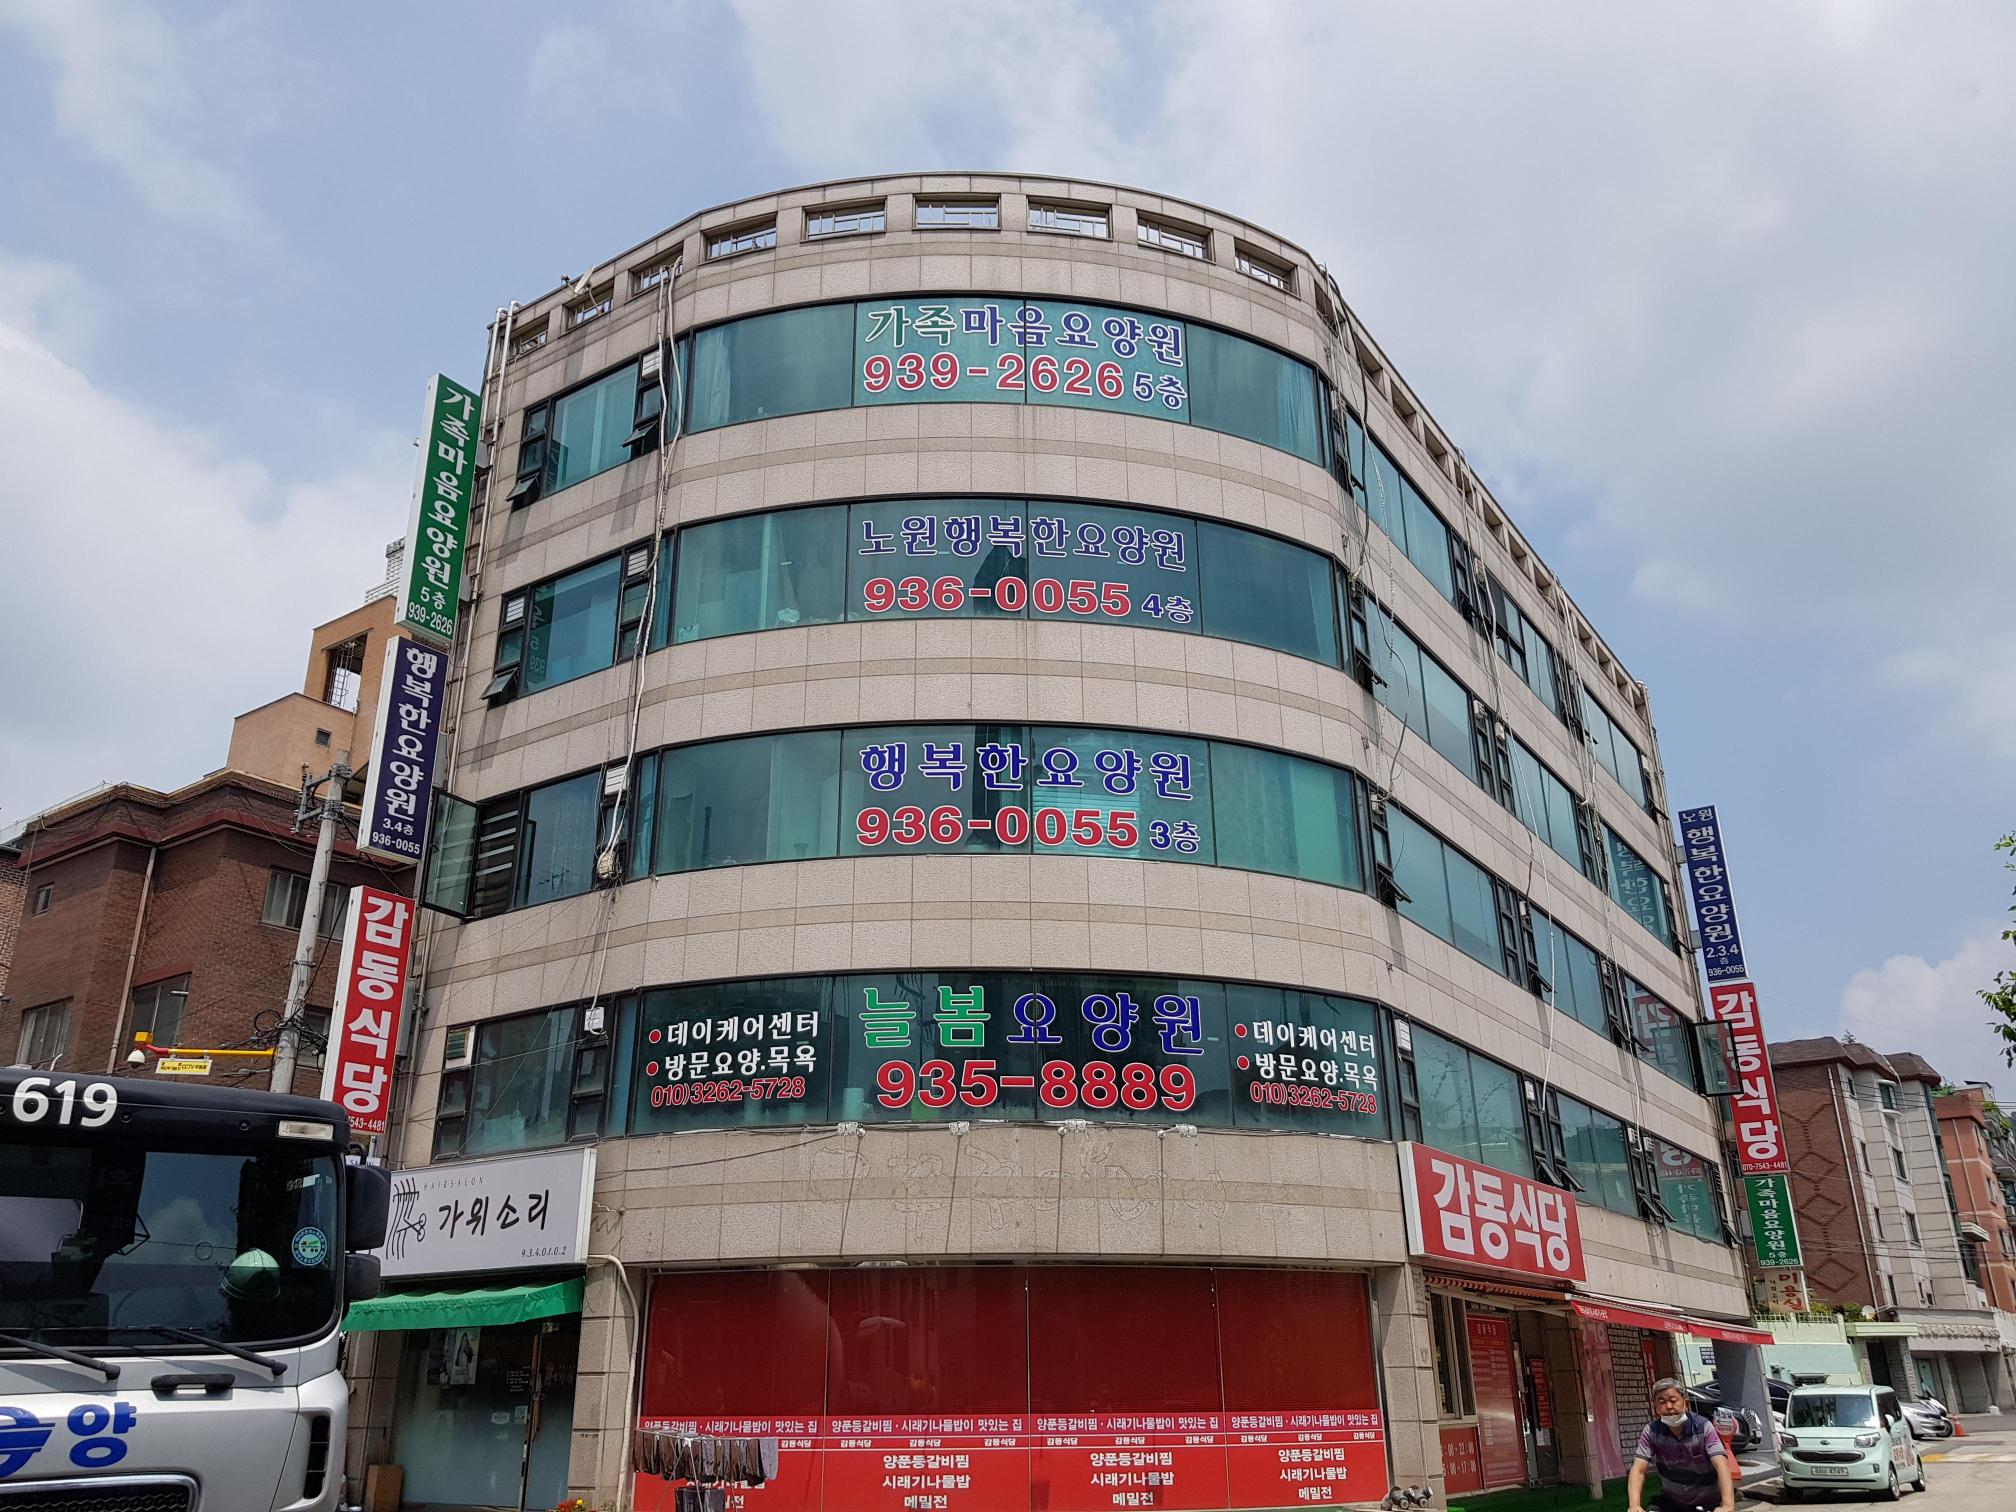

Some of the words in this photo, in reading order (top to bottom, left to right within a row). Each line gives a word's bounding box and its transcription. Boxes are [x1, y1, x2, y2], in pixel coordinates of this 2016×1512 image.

[863, 352, 1124, 399] 939-2626
[1132, 373, 1188, 410] 5층
[421, 386, 475, 590] 가족마음요양원
[420, 586, 446, 610] 5층
[863, 576, 1131, 617] 936-0055
[1142, 594, 1193, 624] 4층
[408, 601, 453, 635] 939-2626
[385, 647, 438, 822] 행복한요양원
[1682, 807, 1714, 824] 노원
[856, 805, 1139, 848] 936-0055
[1149, 820, 1201, 854] 3층
[372, 831, 421, 855] 936-0055
[1686, 826, 1734, 943] 행복한요양원
[1708, 964, 1745, 977] 936-0055
[341, 895, 409, 1114] 감동식당
[667, 1011, 819, 1047] 데이케어센터
[1252, 1021, 1375, 1059] 데이케어센터
[1716, 990, 1779, 1160] 감동식당
[651, 1076, 806, 1108] 010)3262-5728
[876, 1060, 1196, 1111] 935-8889
[13, 1077, 118, 1127] 619
[1250, 1081, 1377, 1114] 010)3262-5728
[439, 1189, 549, 1239] 가위소리
[1430, 1158, 1571, 1272] 감동식당
[1754, 1178, 1787, 1251] 가족마음요양원
[1760, 1258, 1799, 1266] 939-2626
[705, 1420, 771, 1433] 시래기나물밥이
[775, 1421, 804, 1433] 맛있는
[808, 1421, 818, 1433] 집
[832, 1420, 893, 1433] 양푼등갈비찜
[901, 1419, 974, 1432] 시래기나물밥이
[978, 1418, 1008, 1432] 맛있는
[1012, 1418, 1022, 1432] 집
[1037, 1417, 1098, 1431] 양푼등갈비찜
[1106, 1417, 1174, 1431] 시래기나물밥이
[1178, 1416, 1206, 1430] 맛있는
[1209, 1416, 1219, 1430] 집
[1231, 1415, 1283, 1429] 양푼등갈비찜
[1290, 1414, 1345, 1428] 시래기나물밥이
[1347, 1414, 1369, 1426] 맛있는
[1371, 1414, 1378, 1425] 집
[781, 1439, 812, 1448] 감동식당
[840, 1439, 872, 1448] 감동식당
[909, 1438, 941, 1447] 감동식당
[984, 1438, 1016, 1447] 감동식당
[1046, 1437, 1079, 1446] 감동식당
[1115, 1436, 1145, 1445] 감동식당
[1184, 1435, 1214, 1444] 감동식당
[1240, 1435, 1268, 1443] 감동식당
[1297, 1433, 1322, 1442] 감동식당
[1353, 1432, 1375, 1440] 감동식당
[883, 1455, 969, 1469] 양푼등갈비찜
[1090, 1452, 1173, 1466] 양푼등갈비찜
[1278, 1448, 1345, 1463] 양푼등갈비찜
[882, 1475, 971, 1489] 시래기나물밥
[1090, 1472, 1175, 1486] 시래기나물밥
[1280, 1467, 1347, 1482] 시래기나물밥
[1112, 1492, 1154, 1506] 메밀전
[1298, 1487, 1333, 1500] 메밀전
[904, 1495, 948, 1509] 메밀전
